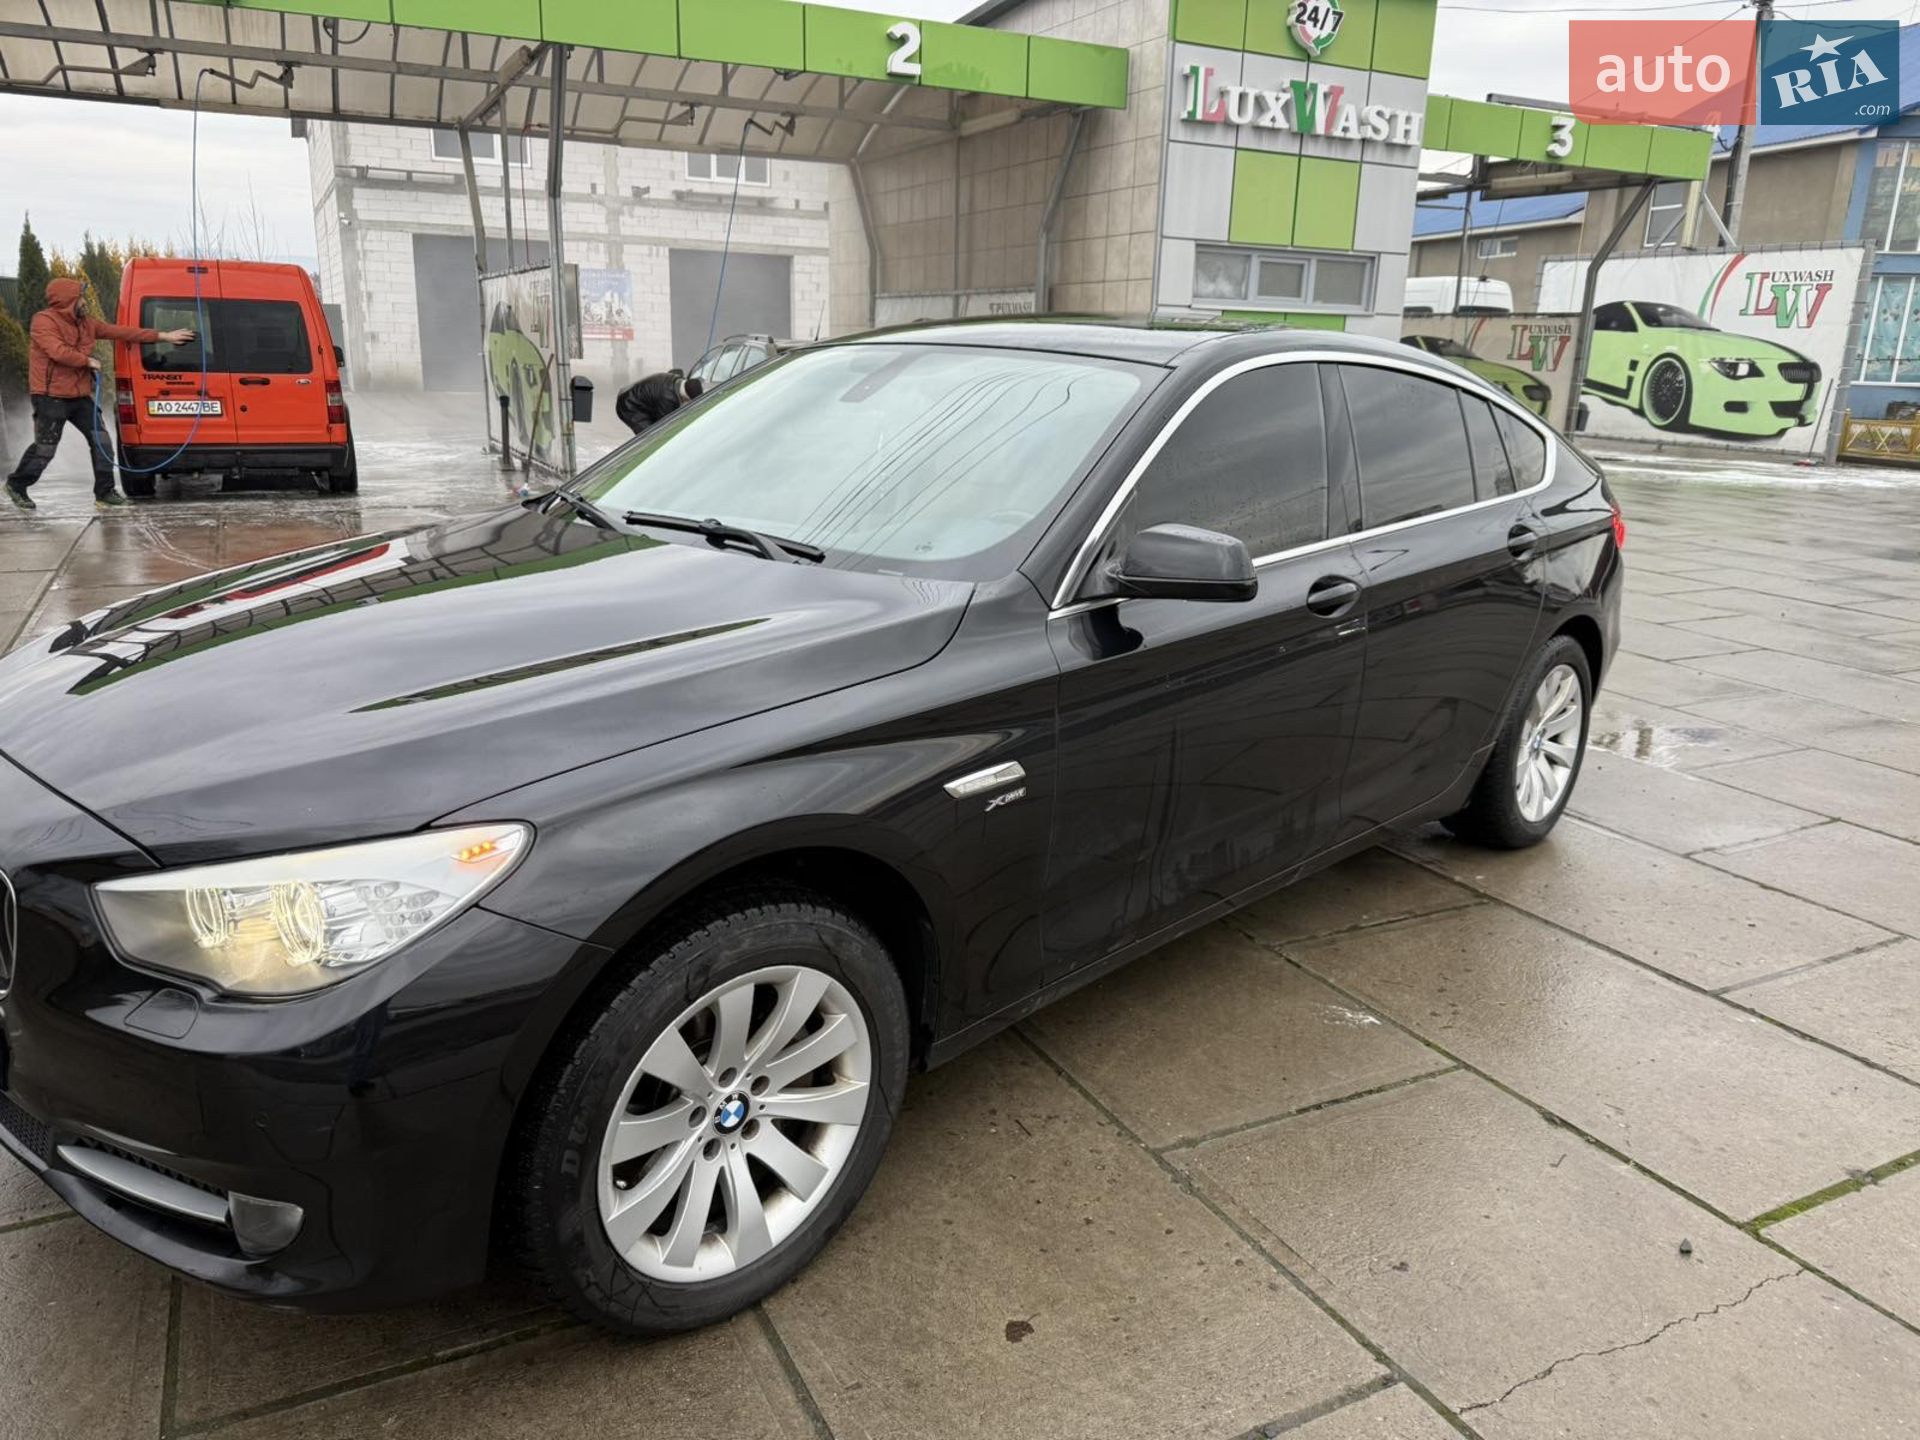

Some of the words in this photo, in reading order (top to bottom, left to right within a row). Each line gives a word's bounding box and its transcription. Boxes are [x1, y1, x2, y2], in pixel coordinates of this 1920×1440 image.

[1295, 2, 1344, 32] 24/7
[887, 21, 921, 77] 2
[1546, 115, 1575, 157] 3
[175, 402, 200, 413] 2447
[202, 402, 219, 413] BE
